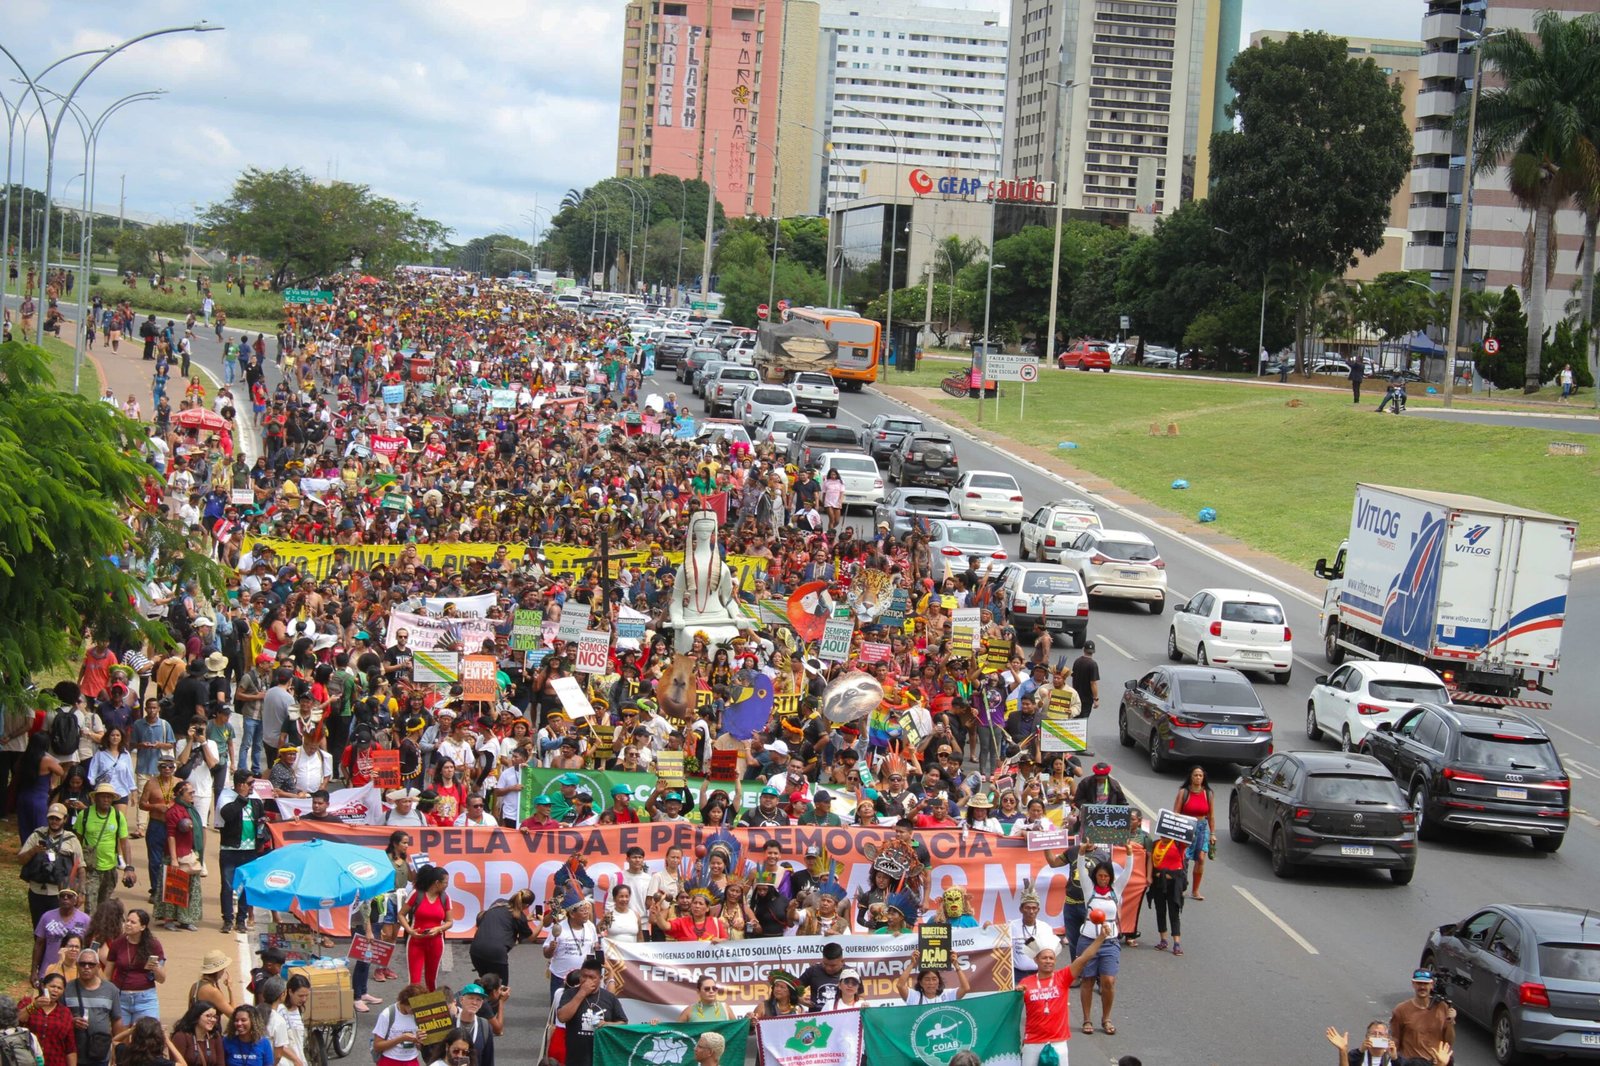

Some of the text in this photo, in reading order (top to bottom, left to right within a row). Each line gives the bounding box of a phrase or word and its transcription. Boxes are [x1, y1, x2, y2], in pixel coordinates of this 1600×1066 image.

[682, 25, 704, 128] FLASH
[938, 176, 1045, 203] GEAP saúde
[1357, 497, 1401, 539] VITLOG
[1455, 543, 1491, 556] VITLOG
[515, 610, 542, 620] POVOS
[1441, 614, 1488, 625] www.vitlog.com.br
[825, 626, 852, 637] SEMPRE
[516, 640, 536, 650] VIDA
[578, 641, 608, 653] SOMOS
[822, 640, 848, 653] AQUI
[464, 668, 480, 679] EM
[1087, 805, 1130, 815] PRESERVAR
[1096, 818, 1127, 829] SOLUÇÃO
[421, 829, 511, 854] PELA
[524, 828, 609, 856] VIDA
[619, 828, 639, 851] E
[921, 926, 948, 935] DIREITOS
[686, 951, 696, 959] DO
[696, 950, 711, 959] RIO
[731, 948, 751, 957] ALTO
[752, 945, 791, 957] SOLIMÕES
[845, 945, 880, 954] QUEREMOS
[880, 945, 904, 953] NOSSOS
[921, 947, 948, 964] AÇÃO
[418, 1018, 452, 1031] CLIMÁTICO
[932, 1040, 959, 1052] COIAB
